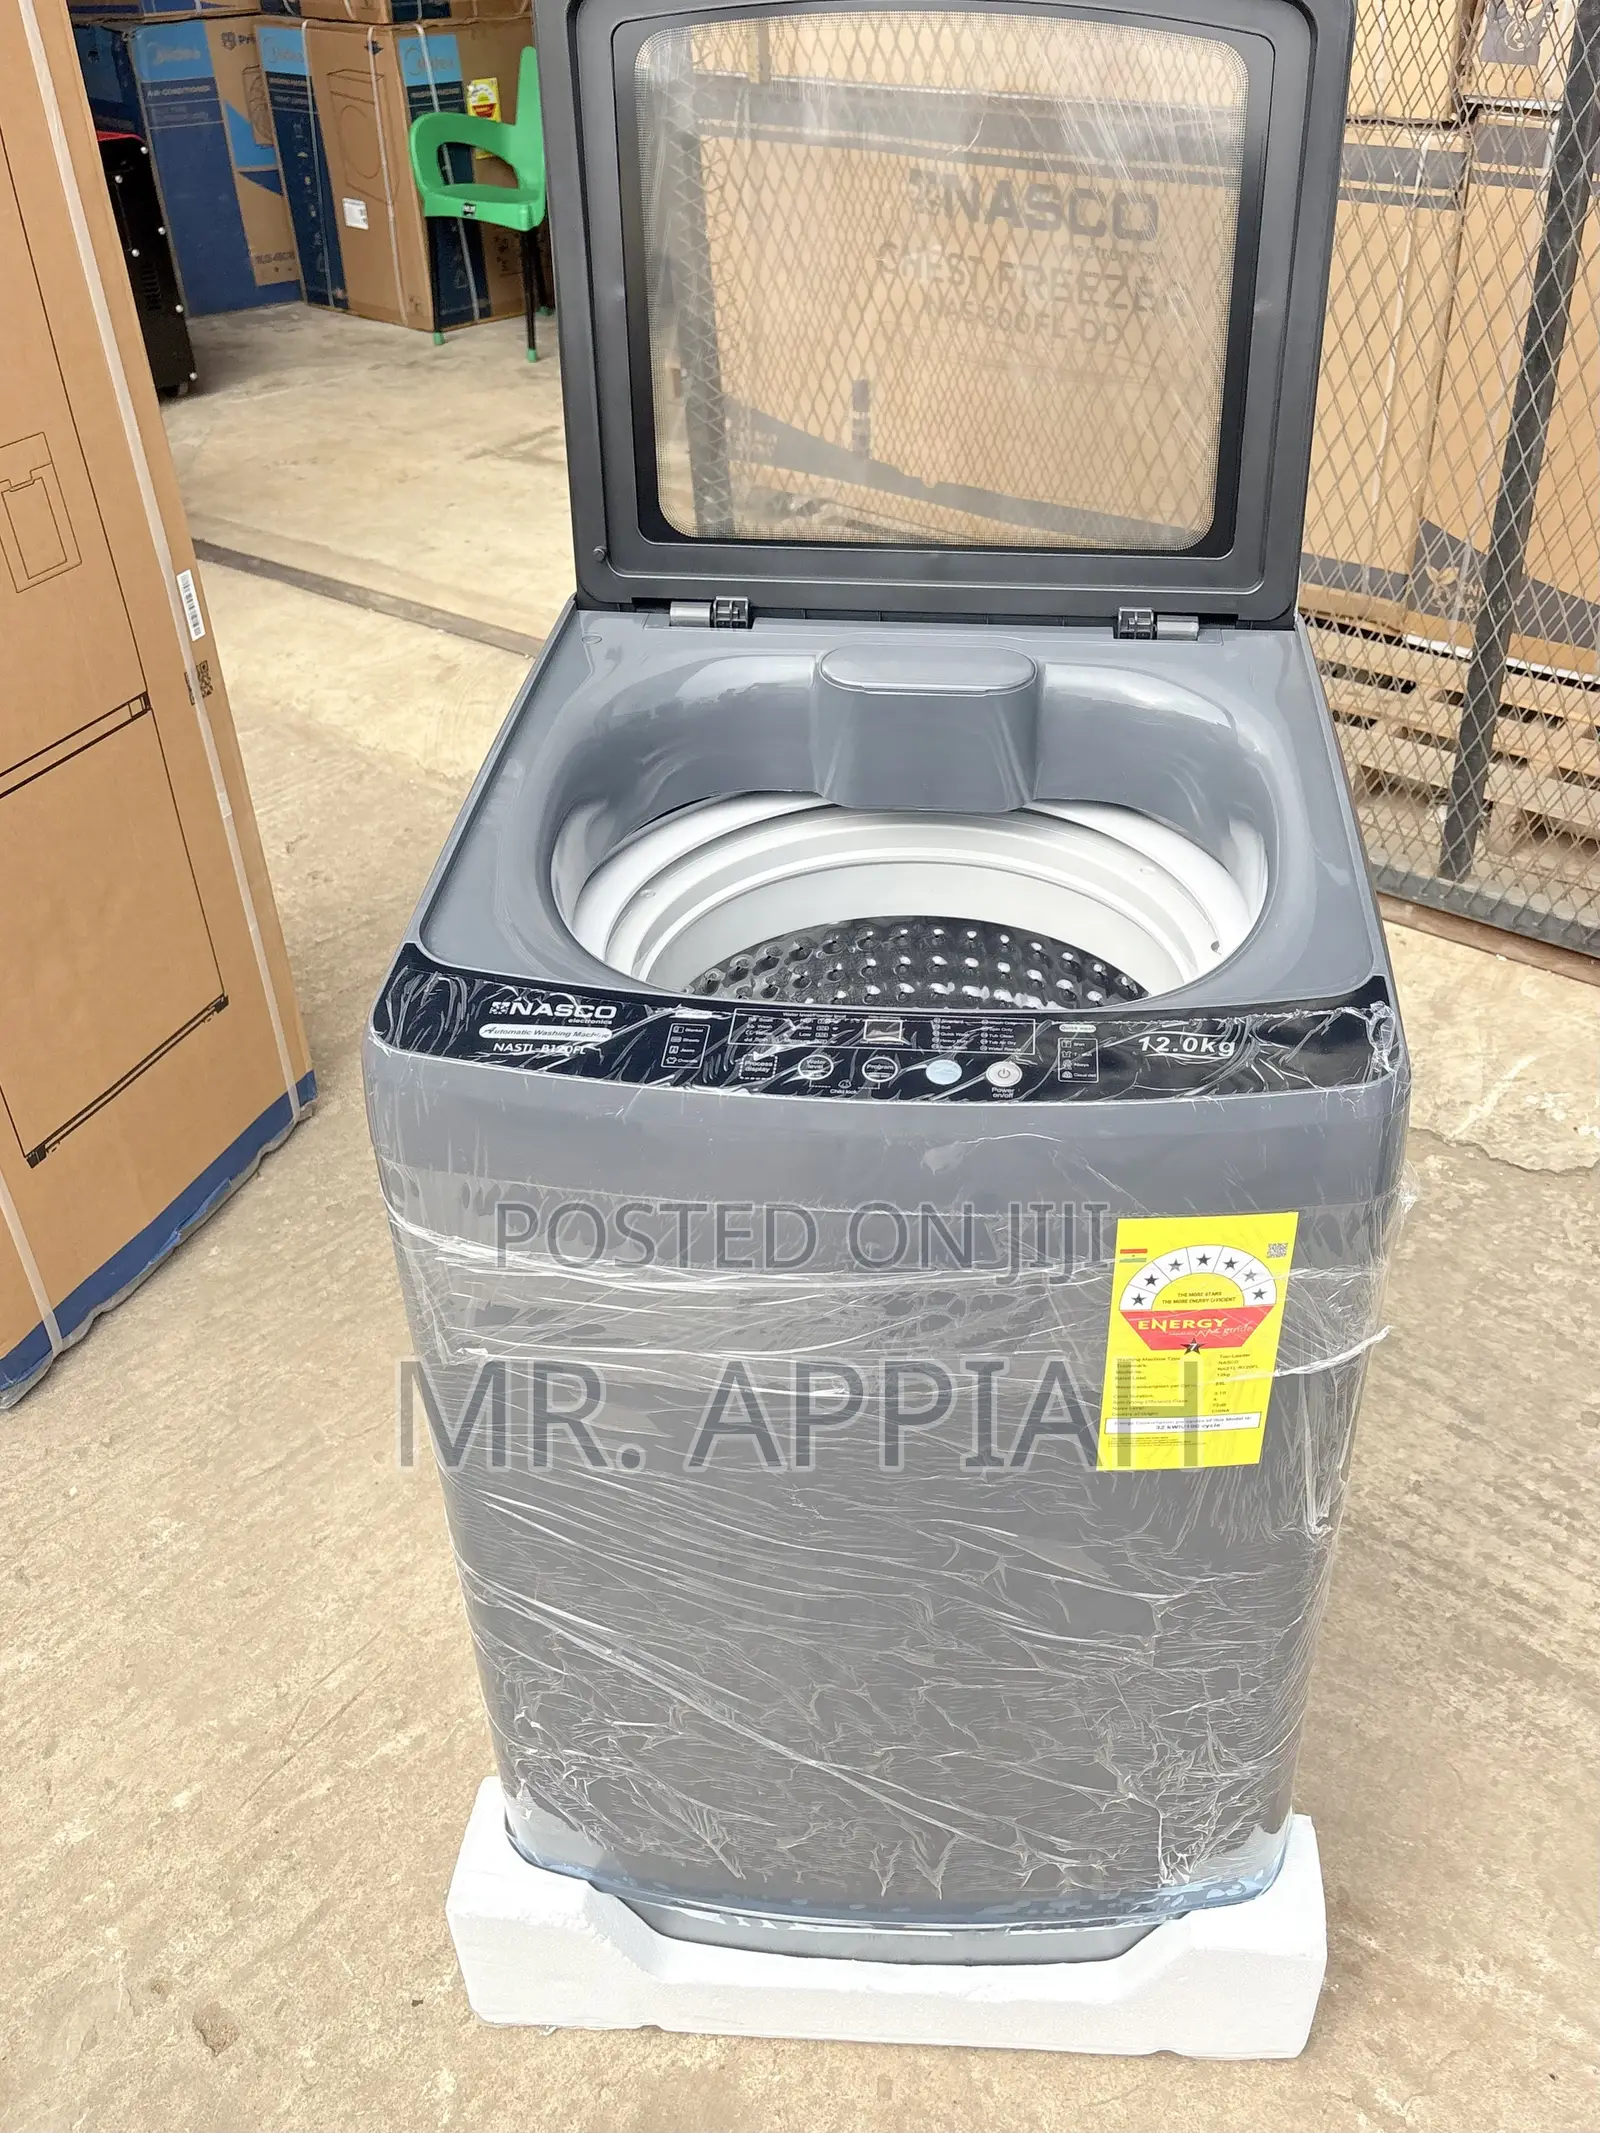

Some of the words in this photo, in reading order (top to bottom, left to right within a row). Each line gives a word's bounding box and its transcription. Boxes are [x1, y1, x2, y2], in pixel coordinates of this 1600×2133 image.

[942, 172, 1160, 242] NASCO
[509, 1001, 617, 1018] NASCO
[481, 1026, 533, 1036] Automatic
[533, 1030, 571, 1038] Washing
[1138, 1035, 1237, 1058] 12.0kg
[745, 1066, 771, 1074] display
[1138, 1317, 1228, 1334] ENERGY
[1190, 1342, 1197, 1351] 7
